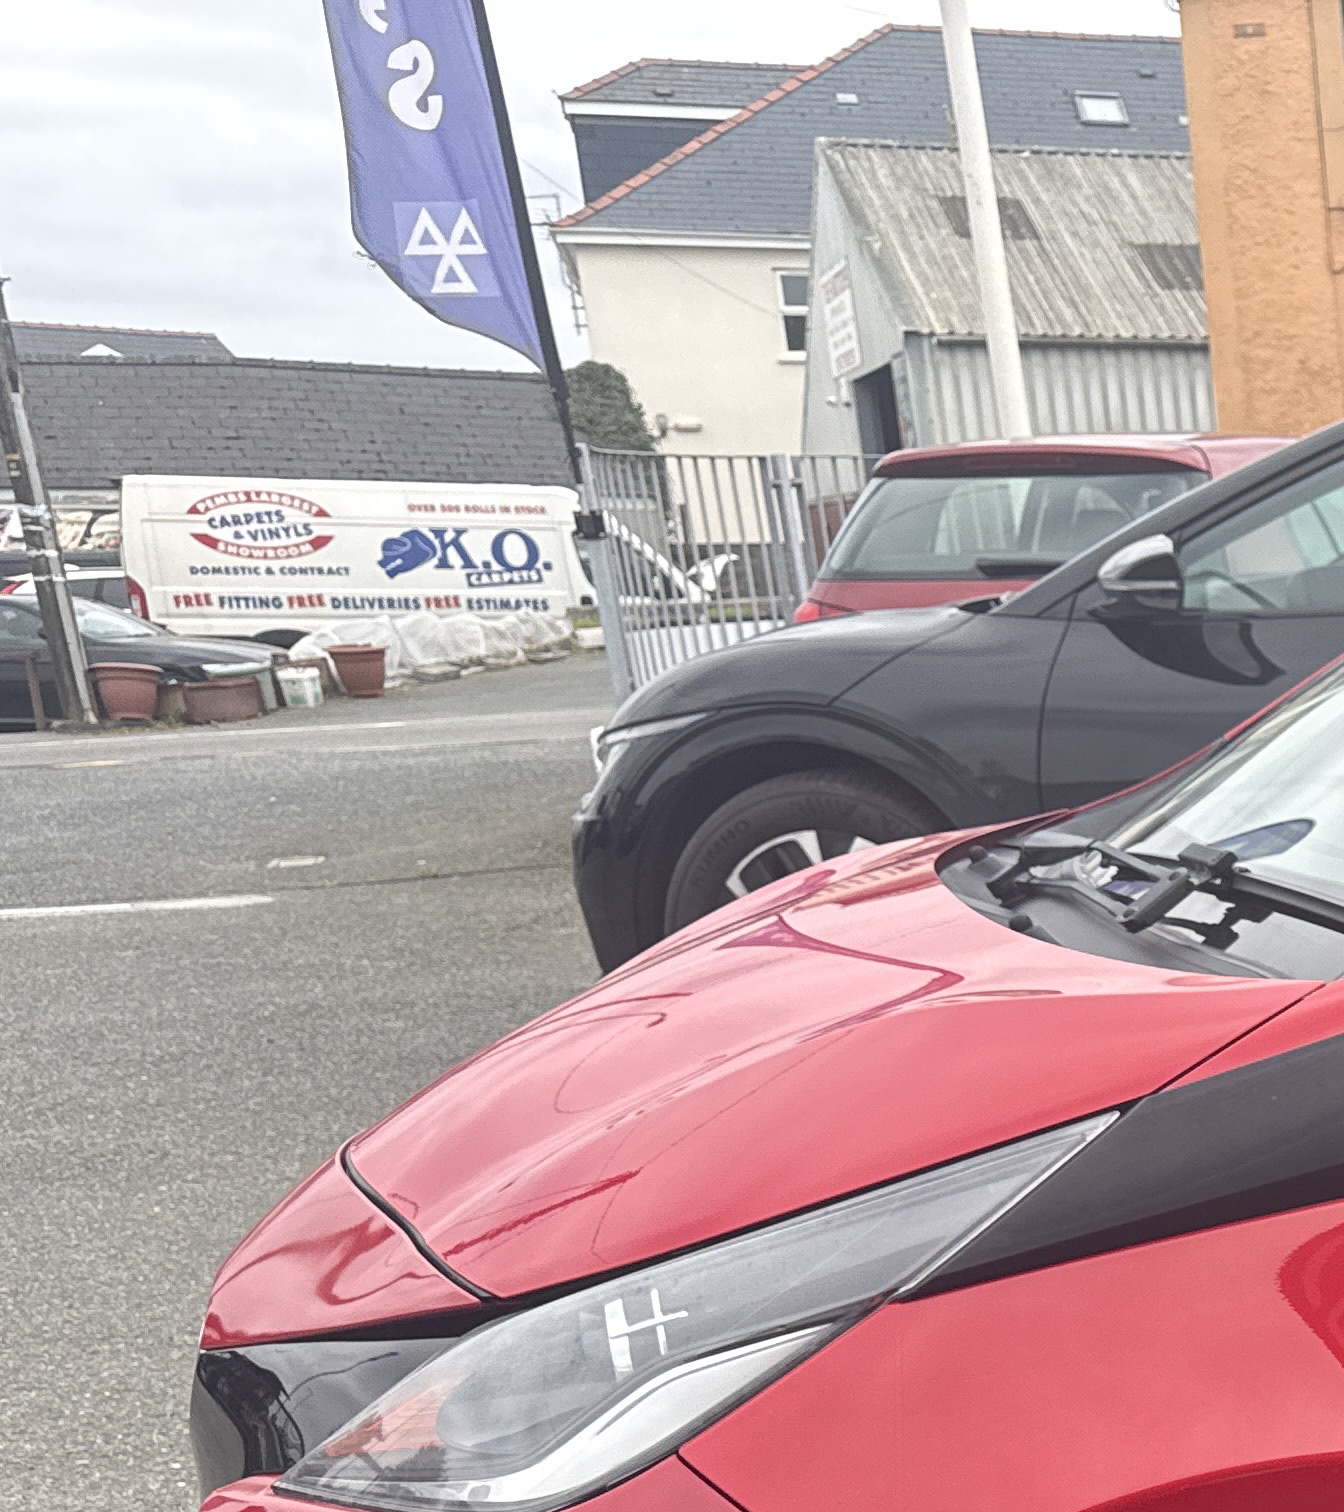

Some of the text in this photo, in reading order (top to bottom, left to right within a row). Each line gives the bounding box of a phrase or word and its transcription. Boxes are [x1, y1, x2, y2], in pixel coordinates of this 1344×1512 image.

[250, 490, 319, 513] LARGEST
[207, 509, 286, 529] CARPETS
[233, 523, 314, 542] & VINYLS
[216, 541, 314, 559] SHOWROOM
[428, 527, 552, 572] K.O.
[189, 565, 350, 577] DOMESTIC & CONTRACT
[469, 571, 541, 586] CARPETS
[173, 593, 549, 611] FREE FITTING FREE DELIVERIES FREE ESTIMATES
